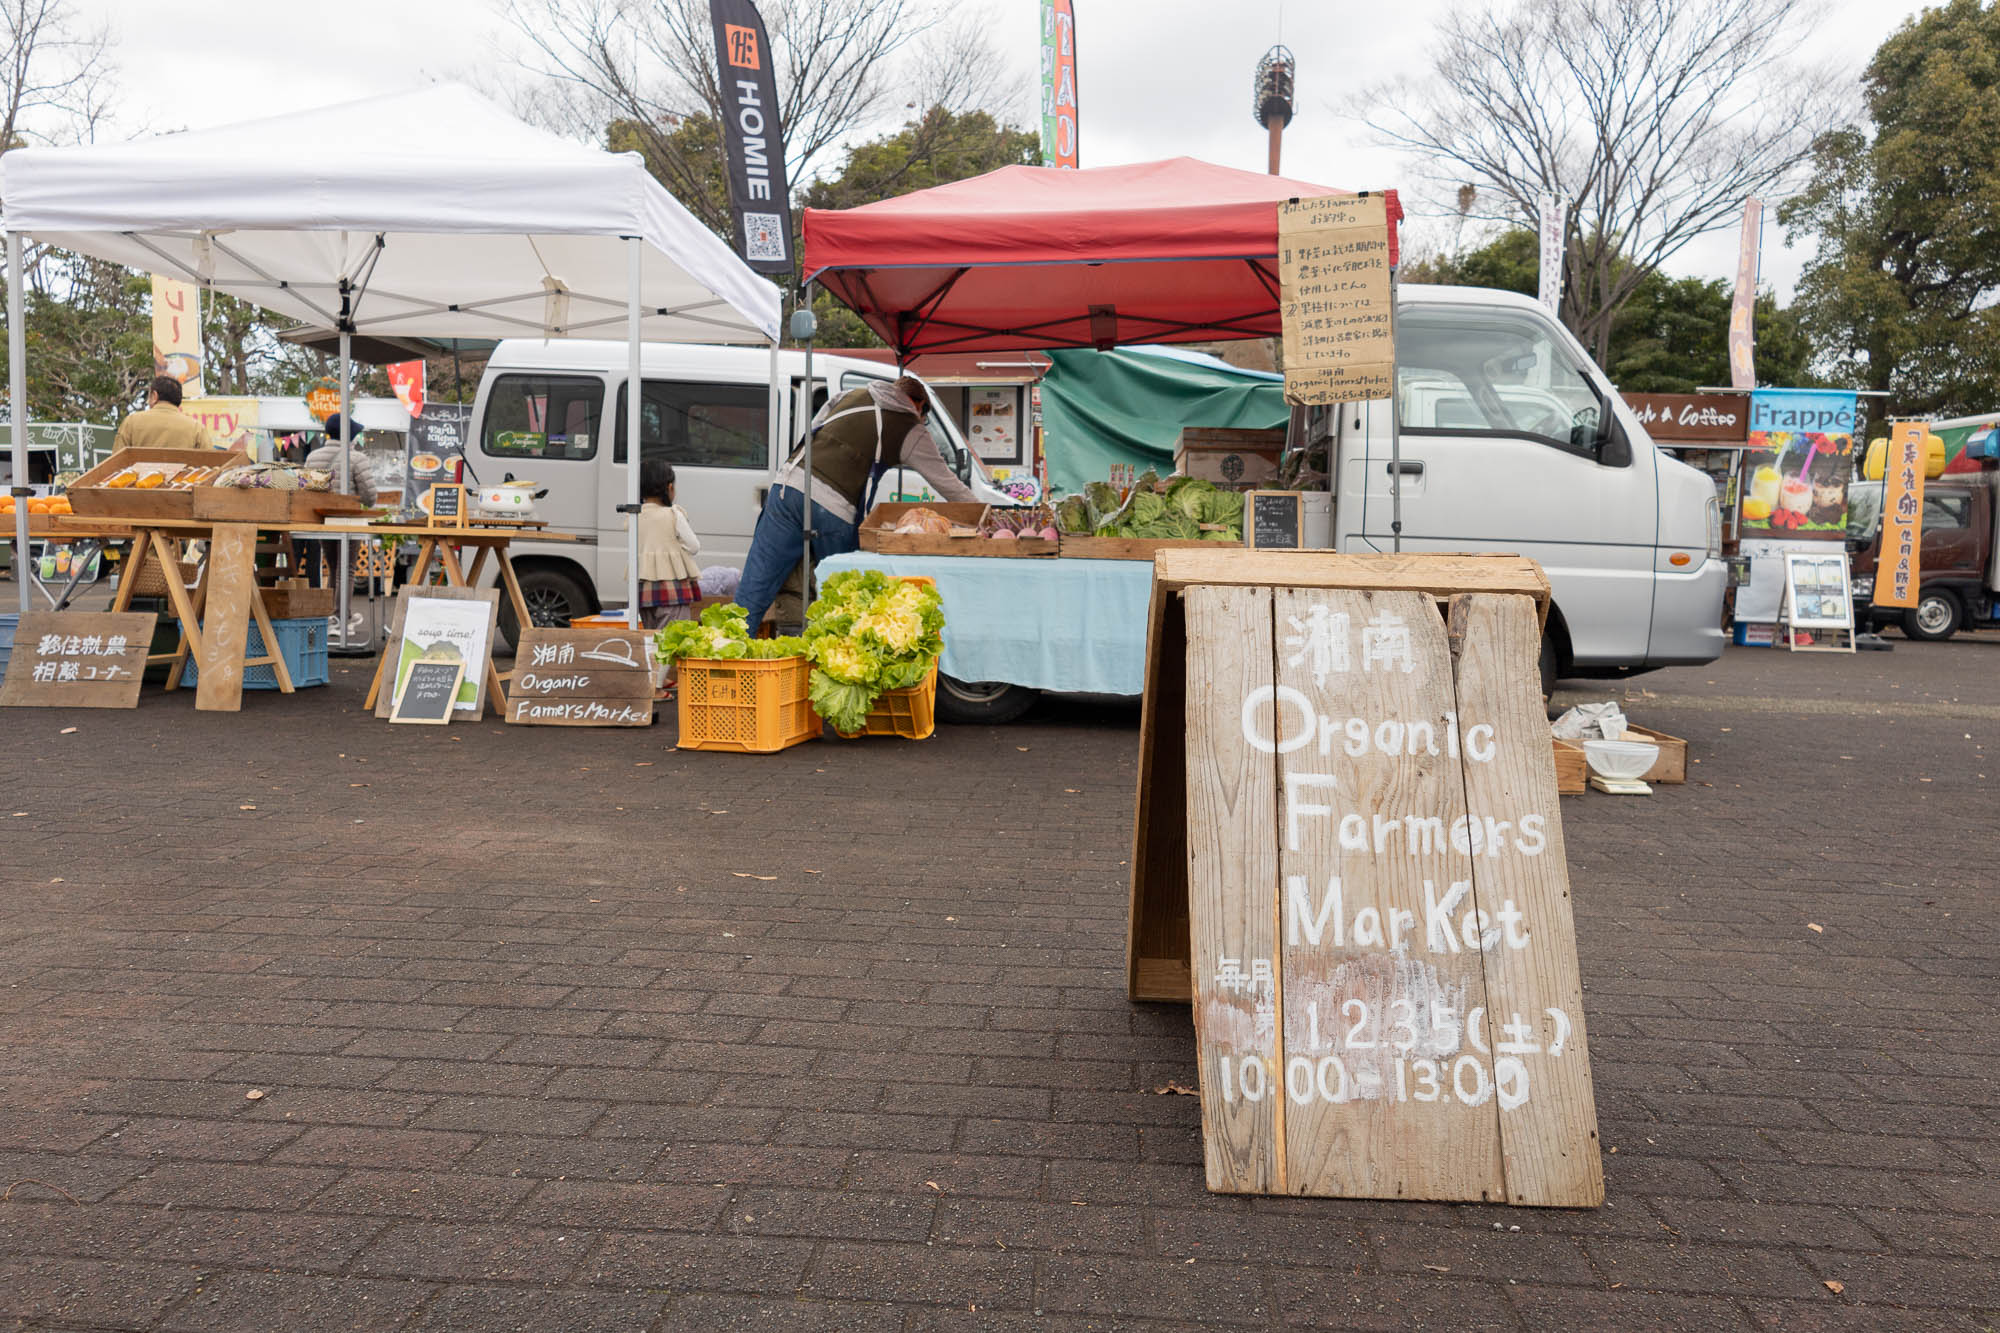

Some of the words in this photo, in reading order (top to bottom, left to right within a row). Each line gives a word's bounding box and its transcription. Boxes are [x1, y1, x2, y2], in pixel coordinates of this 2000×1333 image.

[736, 80, 771, 200] HOMIE
[1678, 404, 1737, 427] Coffee
[1754, 403, 1851, 429] Frappé
[36, 633, 127, 656] 移住就農
[417, 630, 443, 639] soup
[1286, 605, 1417, 686] 湘南
[531, 642, 575, 666] 湘南
[520, 673, 591, 694] Organic
[1241, 684, 1497, 762] Organic
[1285, 772, 1547, 857] Farmers
[1214, 954, 1275, 994] 毎月
